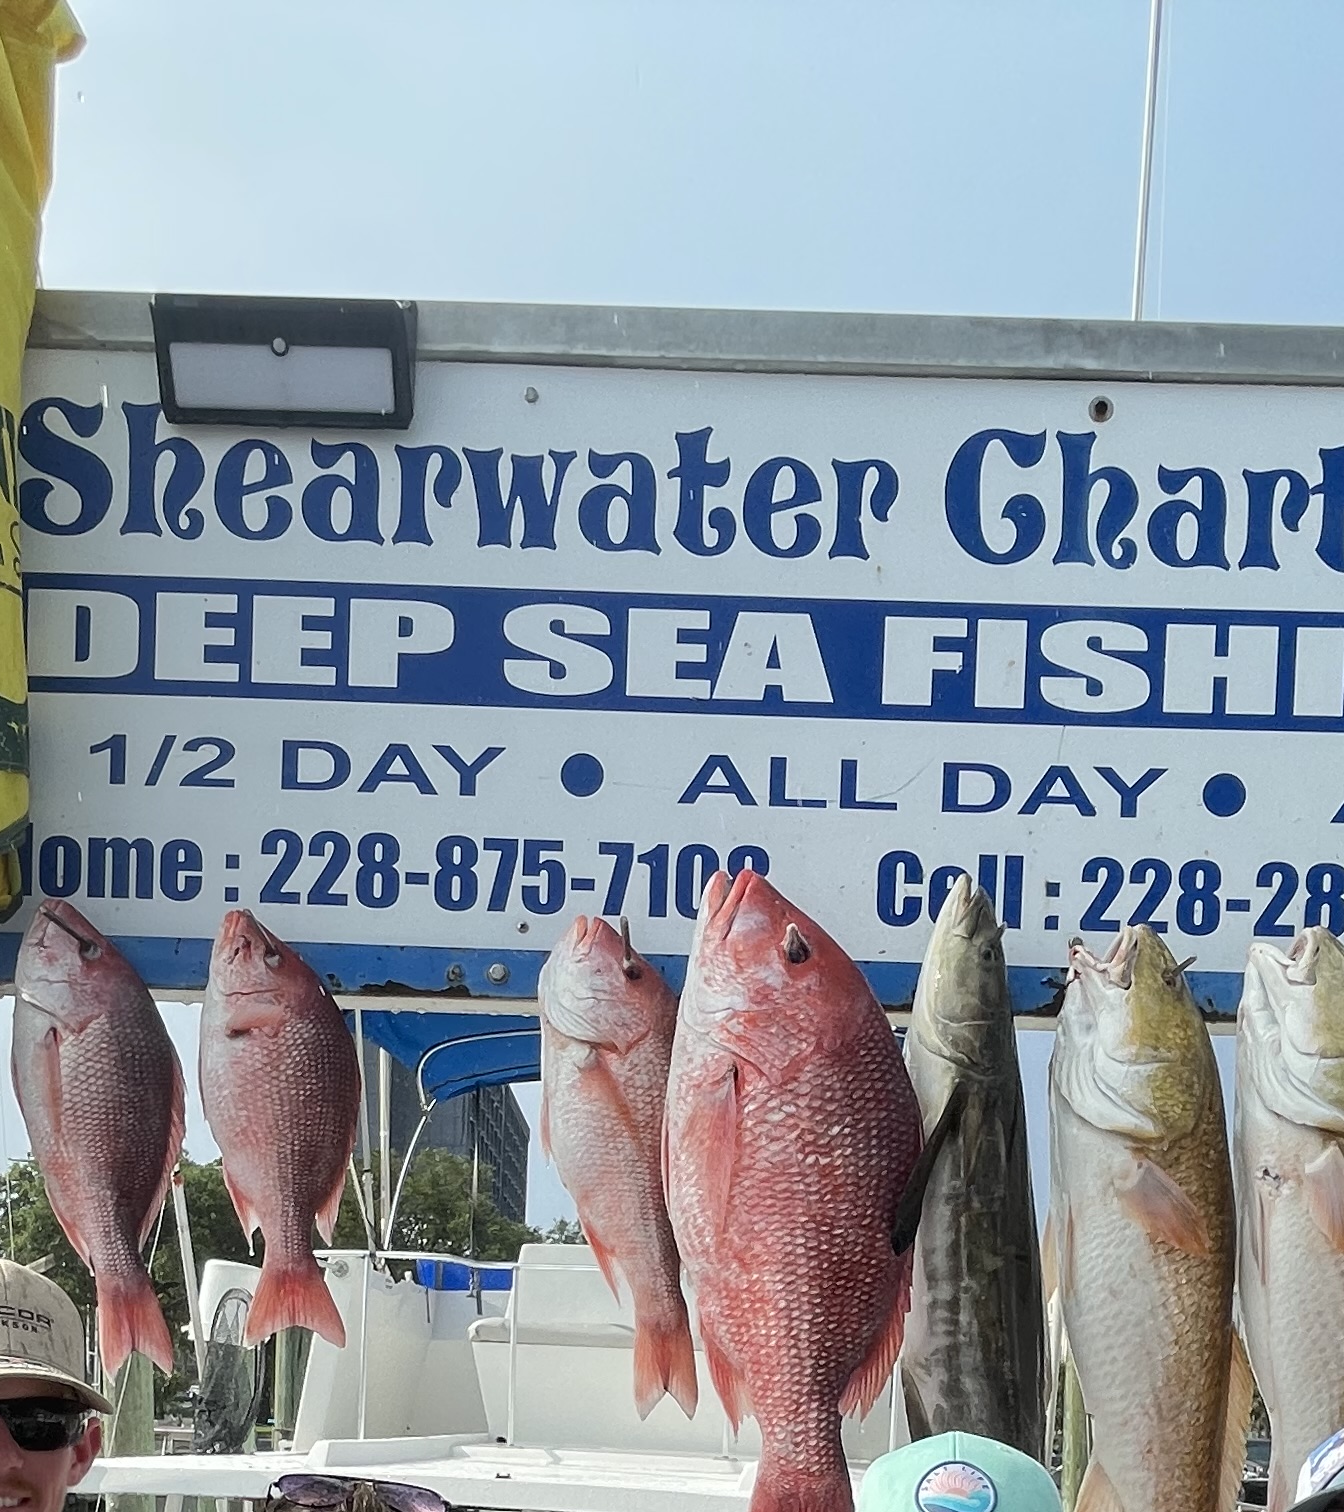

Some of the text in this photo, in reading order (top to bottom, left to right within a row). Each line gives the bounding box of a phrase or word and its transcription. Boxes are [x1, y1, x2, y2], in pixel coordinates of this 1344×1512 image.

[20, 396, 899, 560] Shearwater
[28, 588, 455, 688] DEEP
[503, 603, 834, 704] SEA
[89, 735, 236, 789] 1/2
[281, 741, 504, 797] DAY
[679, 754, 898, 812] ALL
[941, 761, 1167, 818] DAY
